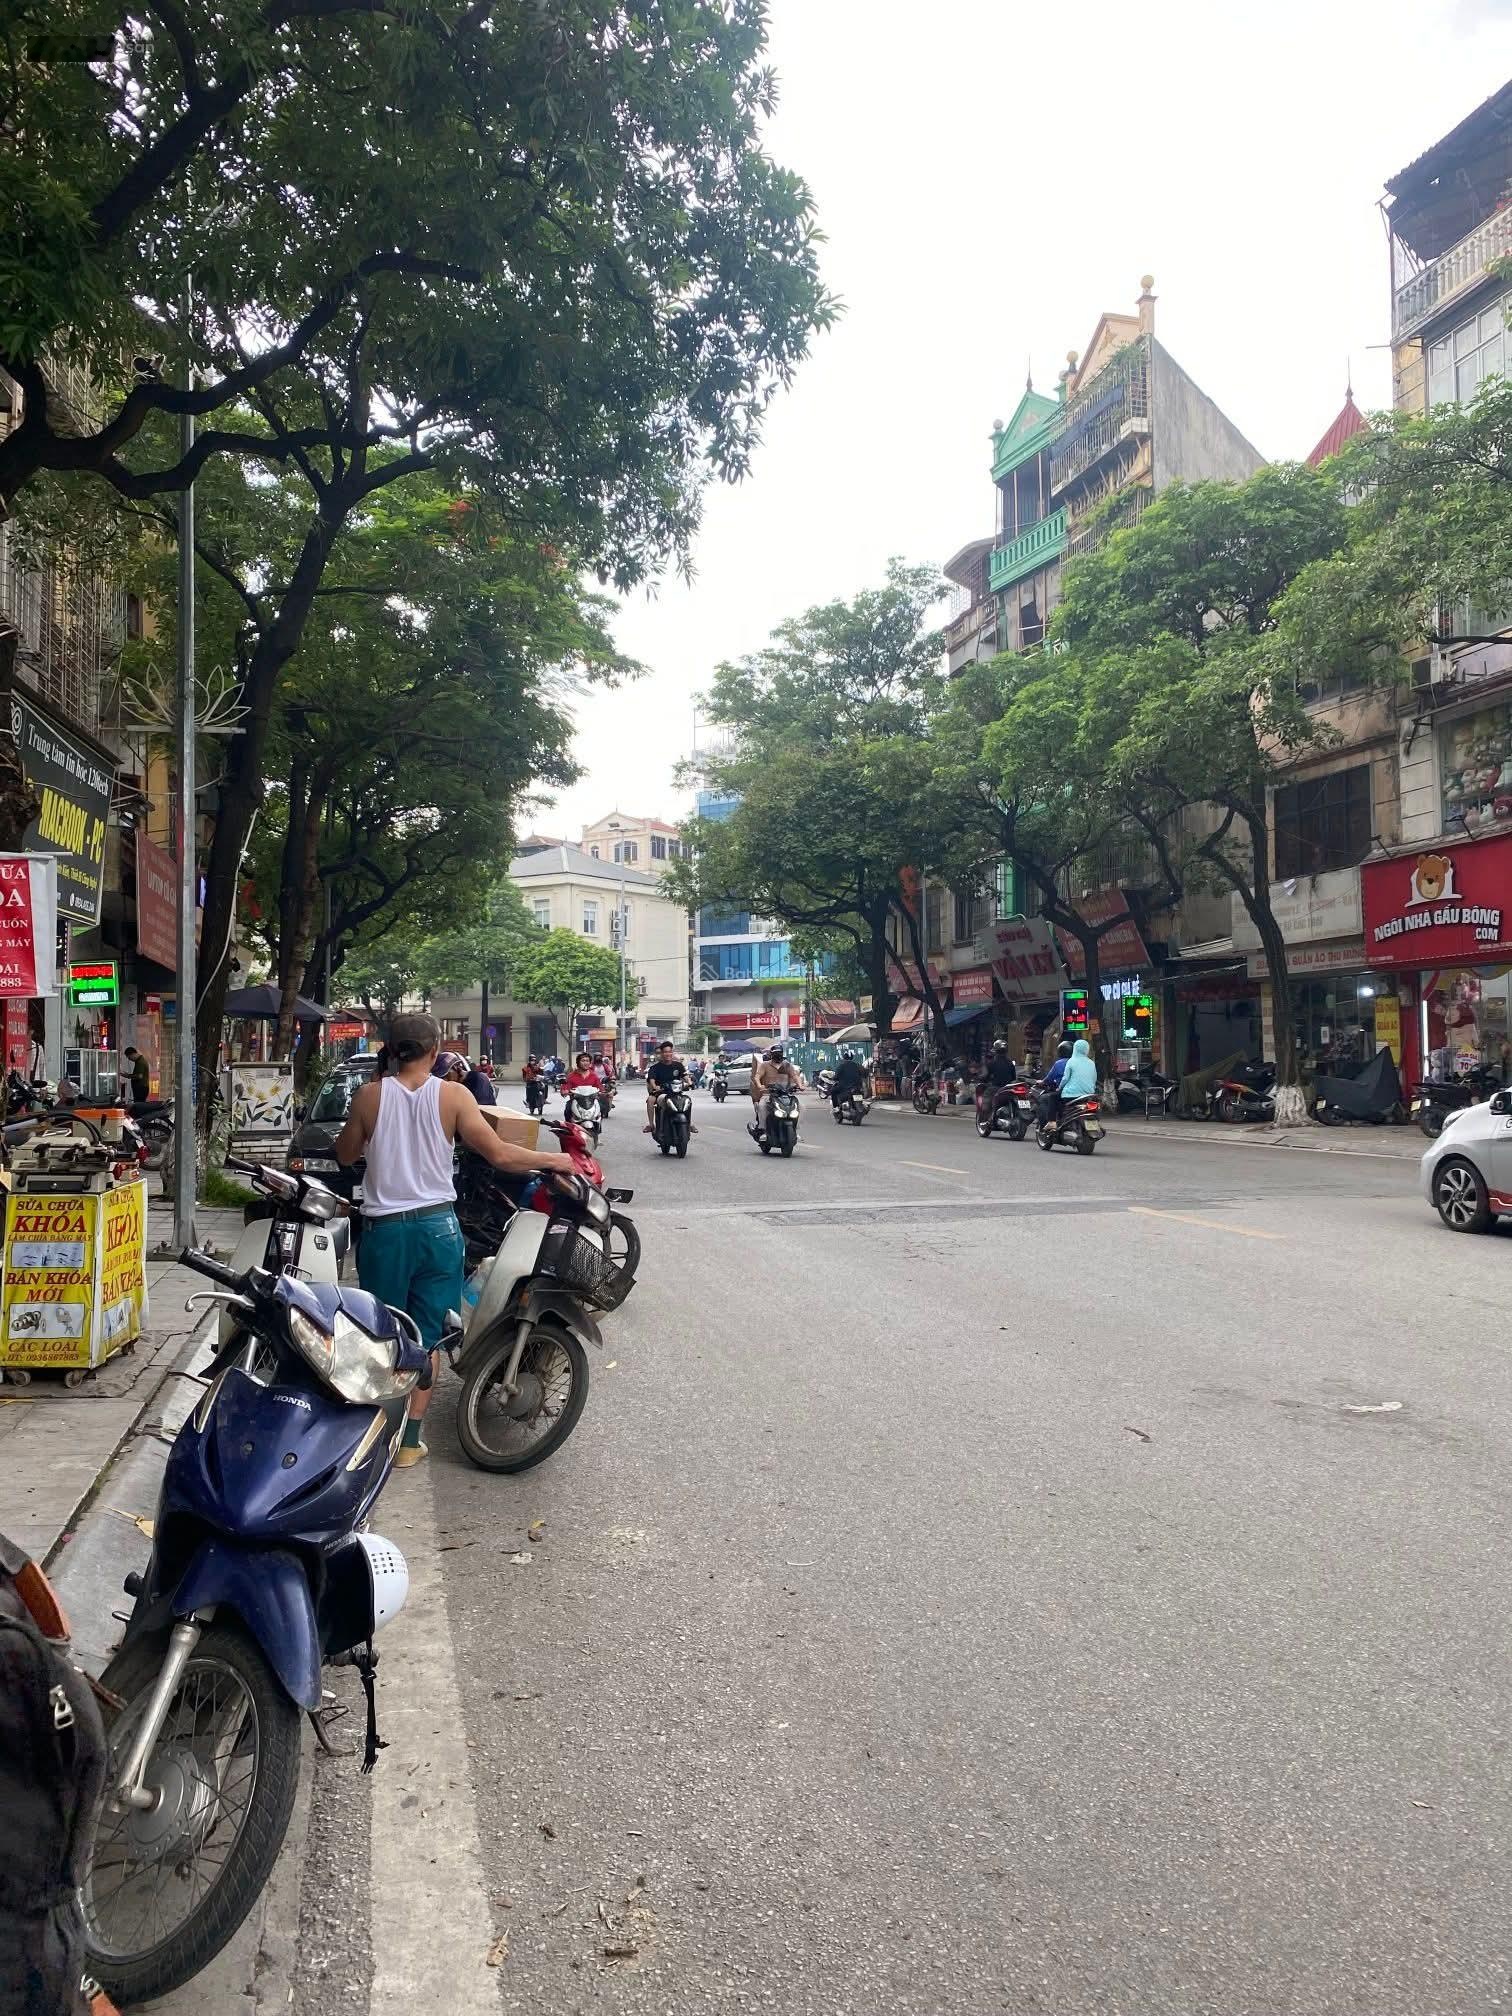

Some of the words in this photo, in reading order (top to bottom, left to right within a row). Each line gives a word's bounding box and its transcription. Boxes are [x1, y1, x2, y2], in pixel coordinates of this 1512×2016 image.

[28, 723, 51, 763] Trung
[38, 787, 88, 856] MACBOOK
[90, 817, 104, 865] PC
[1373, 917, 1403, 943] NGÔI
[1404, 909, 1432, 931] NHÀ
[1433, 903, 1462, 925] GẤU
[1461, 905, 1500, 927] BÔNG
[6, 936, 31, 947] MÁY
[751, 1017, 770, 1025] CIRCLE
[16, 1198, 44, 1211] SỬA
[47, 1198, 85, 1211] CHỮA
[12, 1210, 87, 1233] KHÓA
[4, 1269, 42, 1285] BÁN
[45, 1269, 93, 1285] KHÓA
[25, 1284, 65, 1302] MỚI
[8, 1340, 37, 1353] CÁC
[273, 1394, 312, 1411] HONDA
